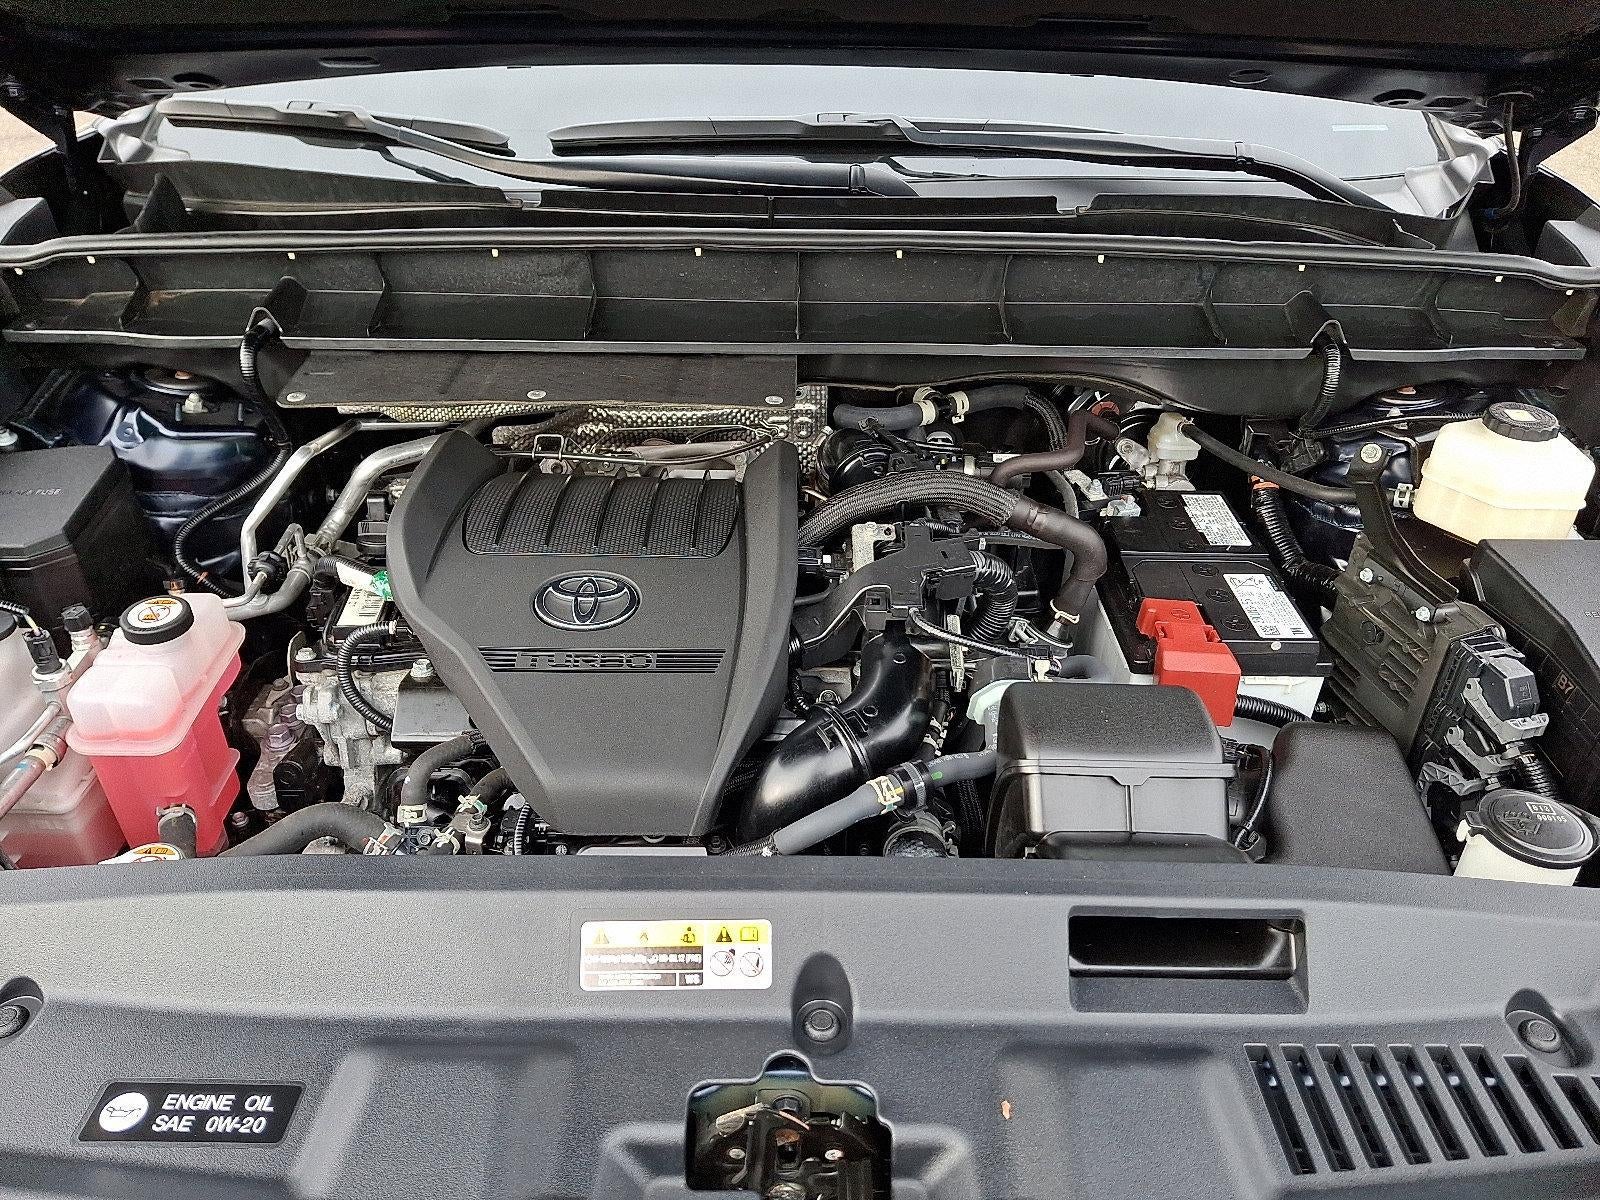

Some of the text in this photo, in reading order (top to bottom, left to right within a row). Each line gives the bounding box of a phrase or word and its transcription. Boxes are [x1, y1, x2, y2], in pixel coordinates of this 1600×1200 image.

[513, 651, 659, 669] TURBO
[1558, 673, 1575, 695] B7
[161, 1093, 275, 1112] ENGINE OIL
[152, 1115, 267, 1134] SAE 0W-20
